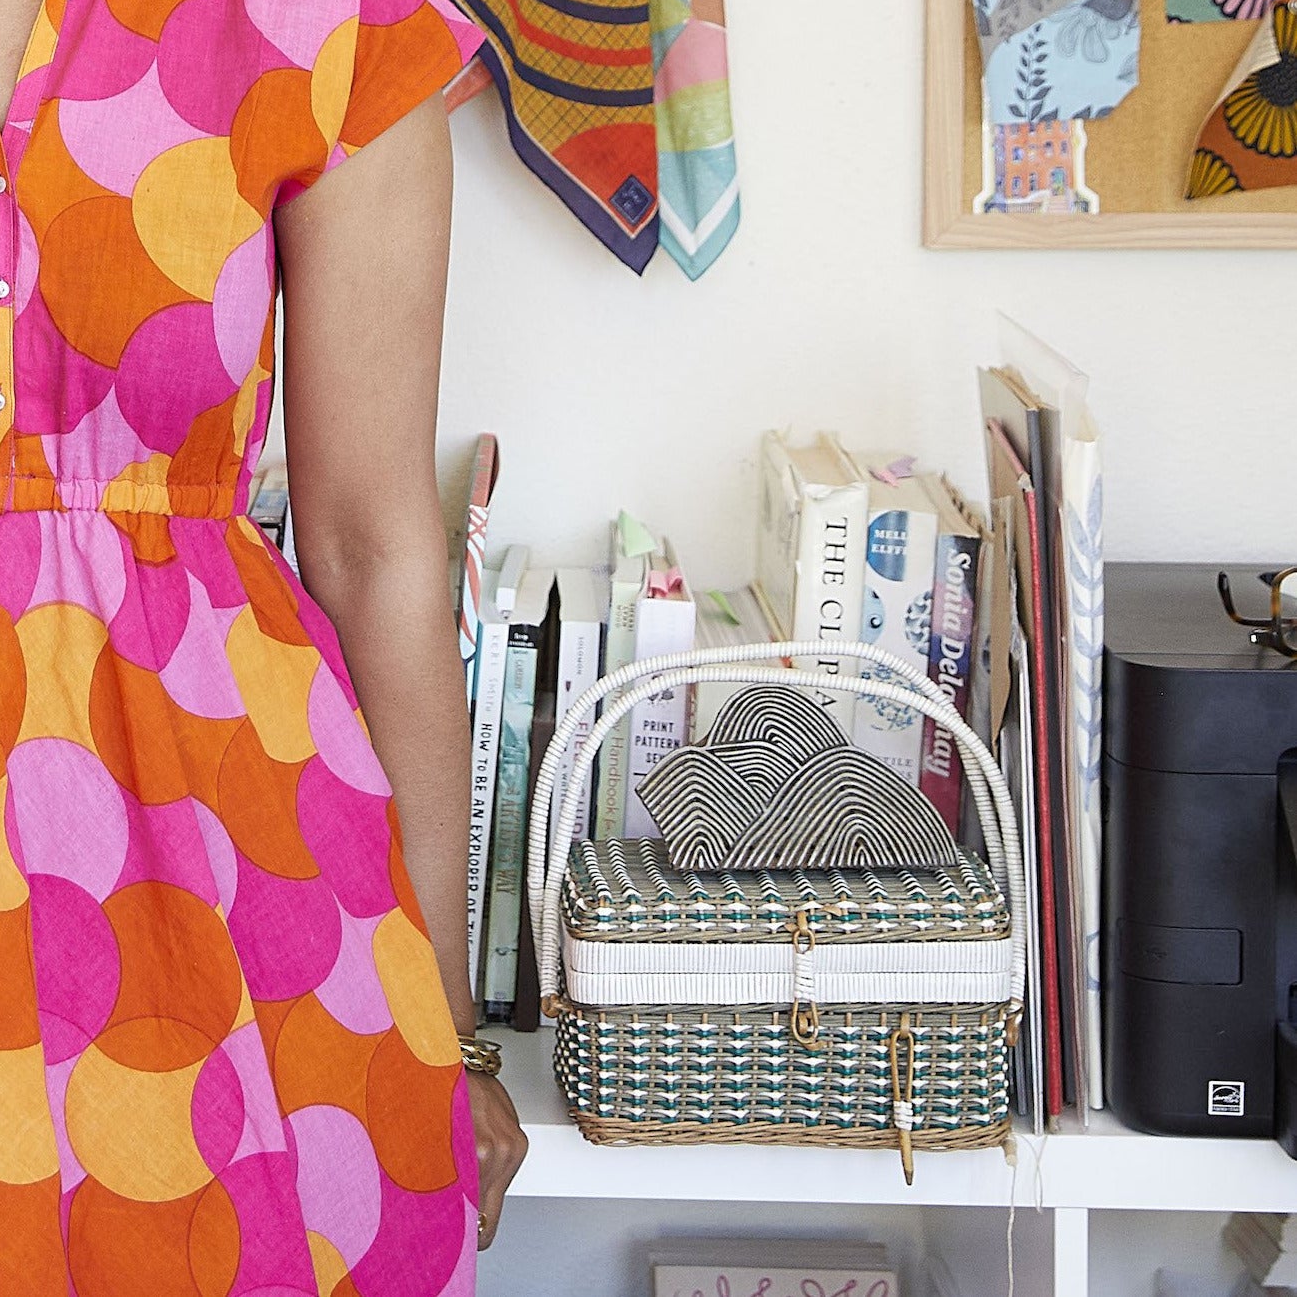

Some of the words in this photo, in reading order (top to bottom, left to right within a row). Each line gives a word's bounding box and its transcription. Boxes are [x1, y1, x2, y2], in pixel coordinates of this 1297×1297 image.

[822, 516, 848, 585] THE
[942, 549, 971, 633] Sonia
[818, 600, 843, 675] CLP
[643, 720, 674, 733] PRINT
[925, 635, 965, 777] Delanay
[479, 723, 492, 751] HOW
[635, 736, 680, 749] PATTERN
[474, 776, 488, 791] BE
[606, 737, 624, 814] Handbook
[472, 798, 485, 818] AN
